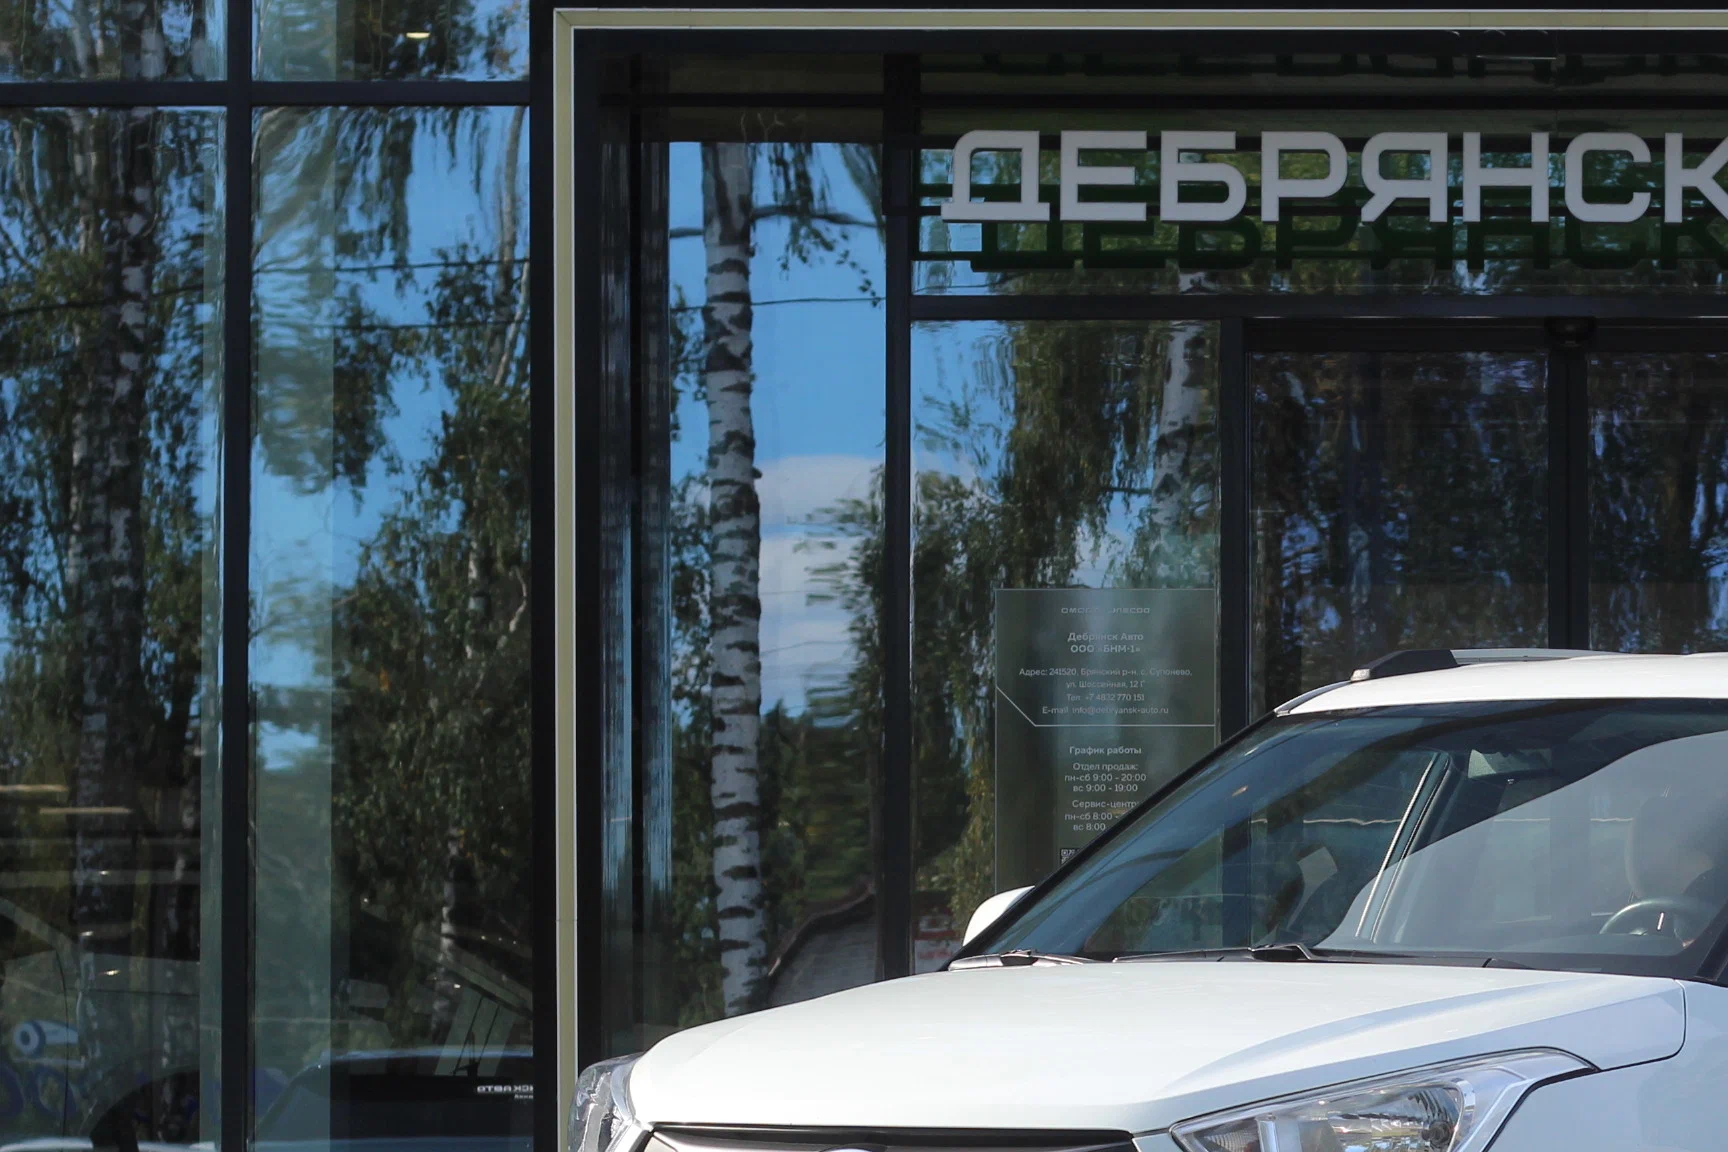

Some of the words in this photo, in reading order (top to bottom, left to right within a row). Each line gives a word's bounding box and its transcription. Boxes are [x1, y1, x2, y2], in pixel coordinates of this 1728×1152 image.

[1120, 632, 1144, 641] Авто
[1070, 645, 1095, 653] ООО
[1019, 668, 1048, 677] Адрес:
[1129, 680, 1138, 688] 12
[1117, 693, 1132, 701] 770
[1133, 693, 1145, 701] 151
[1069, 746, 1105, 756] График
[1107, 746, 1142, 755] работы
[1072, 762, 1100, 771] Отдел
[1101, 763, 1139, 772] продаж:
[1064, 773, 1091, 781] пн-сб
[1092, 773, 1113, 781] 9:00
[1121, 773, 1147, 781] 20:00
[1085, 784, 1106, 792] 9:00
[1114, 784, 1138, 792] 19:00
[1064, 812, 1091, 820] пн-сб
[1092, 812, 1113, 820] 8:00
[1085, 823, 1106, 831] 8:00
